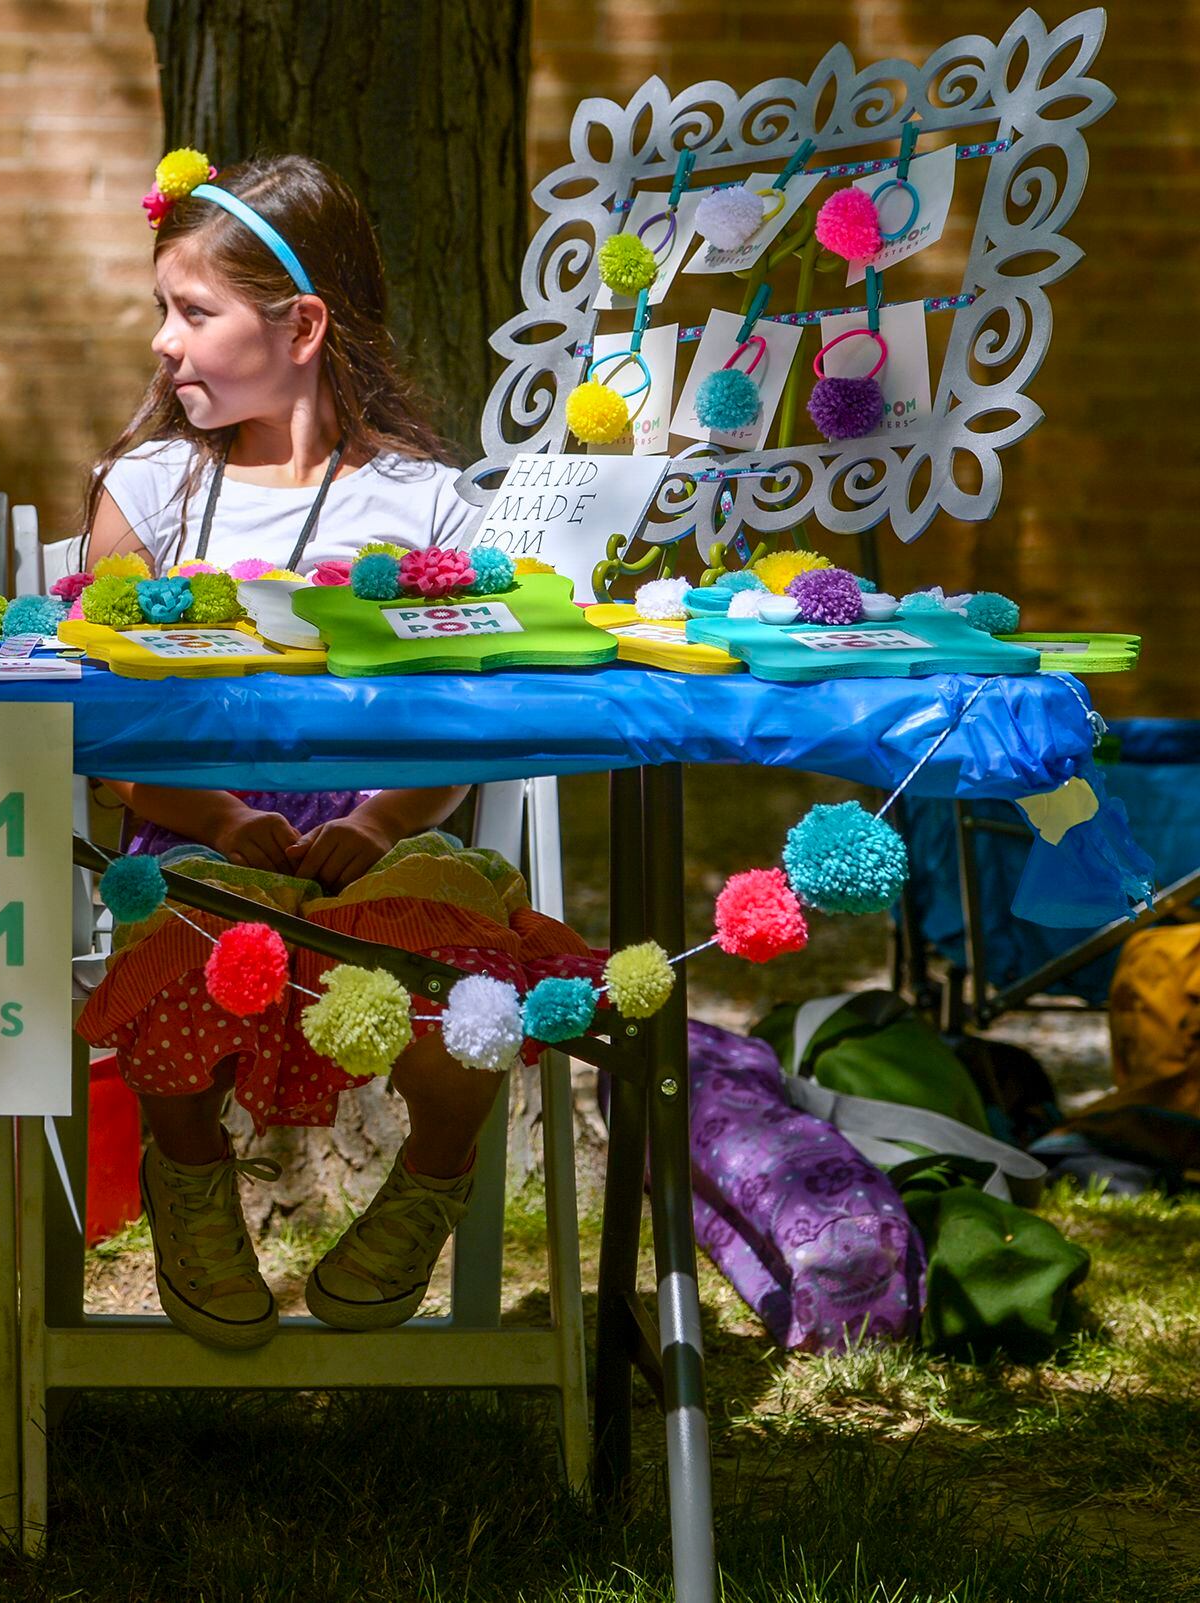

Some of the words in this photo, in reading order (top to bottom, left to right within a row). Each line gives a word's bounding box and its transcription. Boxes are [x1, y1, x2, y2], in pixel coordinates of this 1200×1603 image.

[884, 398, 916, 416] POM
[634, 416, 660, 432] POM
[507, 460, 599, 487] HAND
[487, 493, 597, 525] MADE
[480, 528, 546, 554] POM
[398, 606, 493, 622] POM
[408, 619, 501, 633] POM
[140, 634, 232, 643] POM
[152, 641, 245, 649] POM
